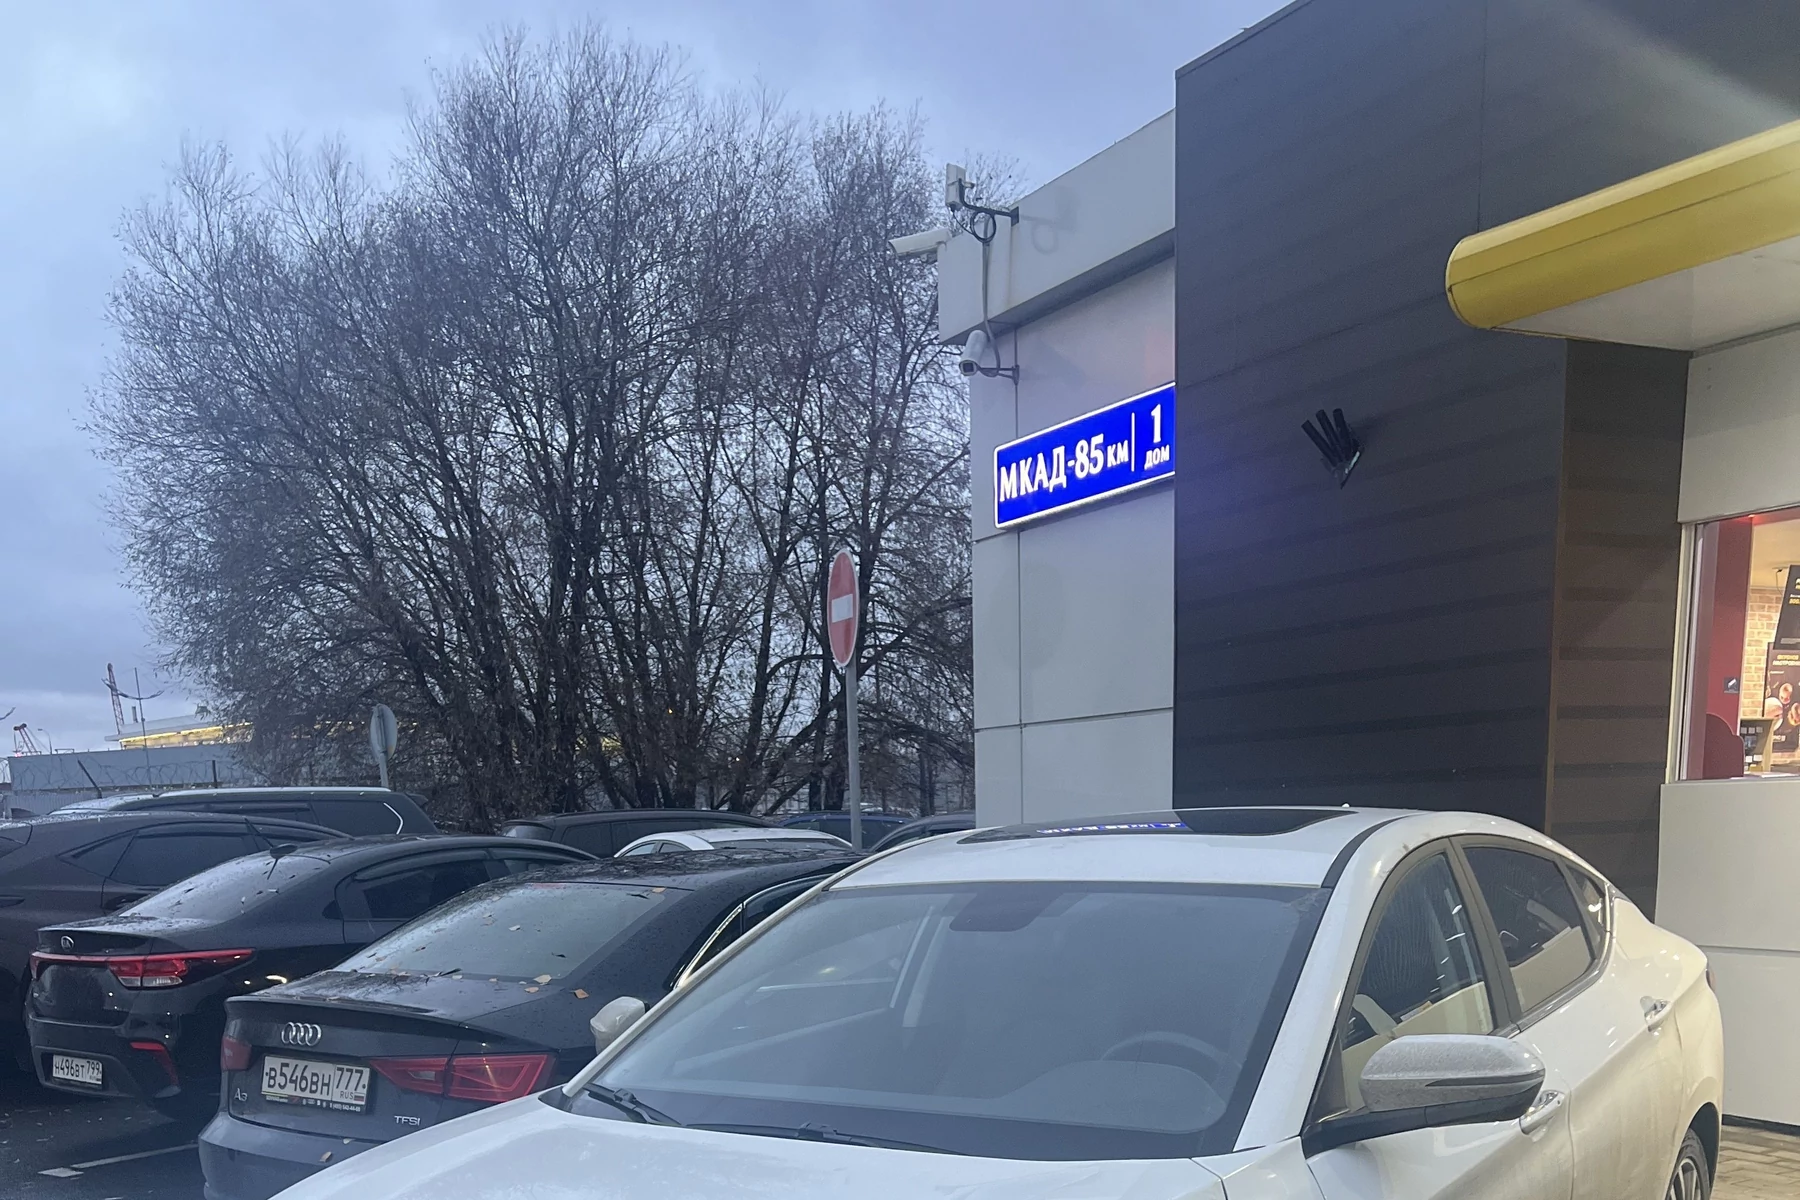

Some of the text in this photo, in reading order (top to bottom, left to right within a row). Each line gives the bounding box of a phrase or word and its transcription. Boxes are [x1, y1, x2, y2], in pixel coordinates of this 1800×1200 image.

[1150, 403, 1162, 443] 1
[999, 433, 1105, 502] МКАД-85
[87, 1061, 100, 1076] 799
[267, 1062, 364, 1096] В546ВН 777
[234, 1087, 248, 1101] A3
[340, 1091, 354, 1100] RUS
[394, 1115, 421, 1126] TFSI
